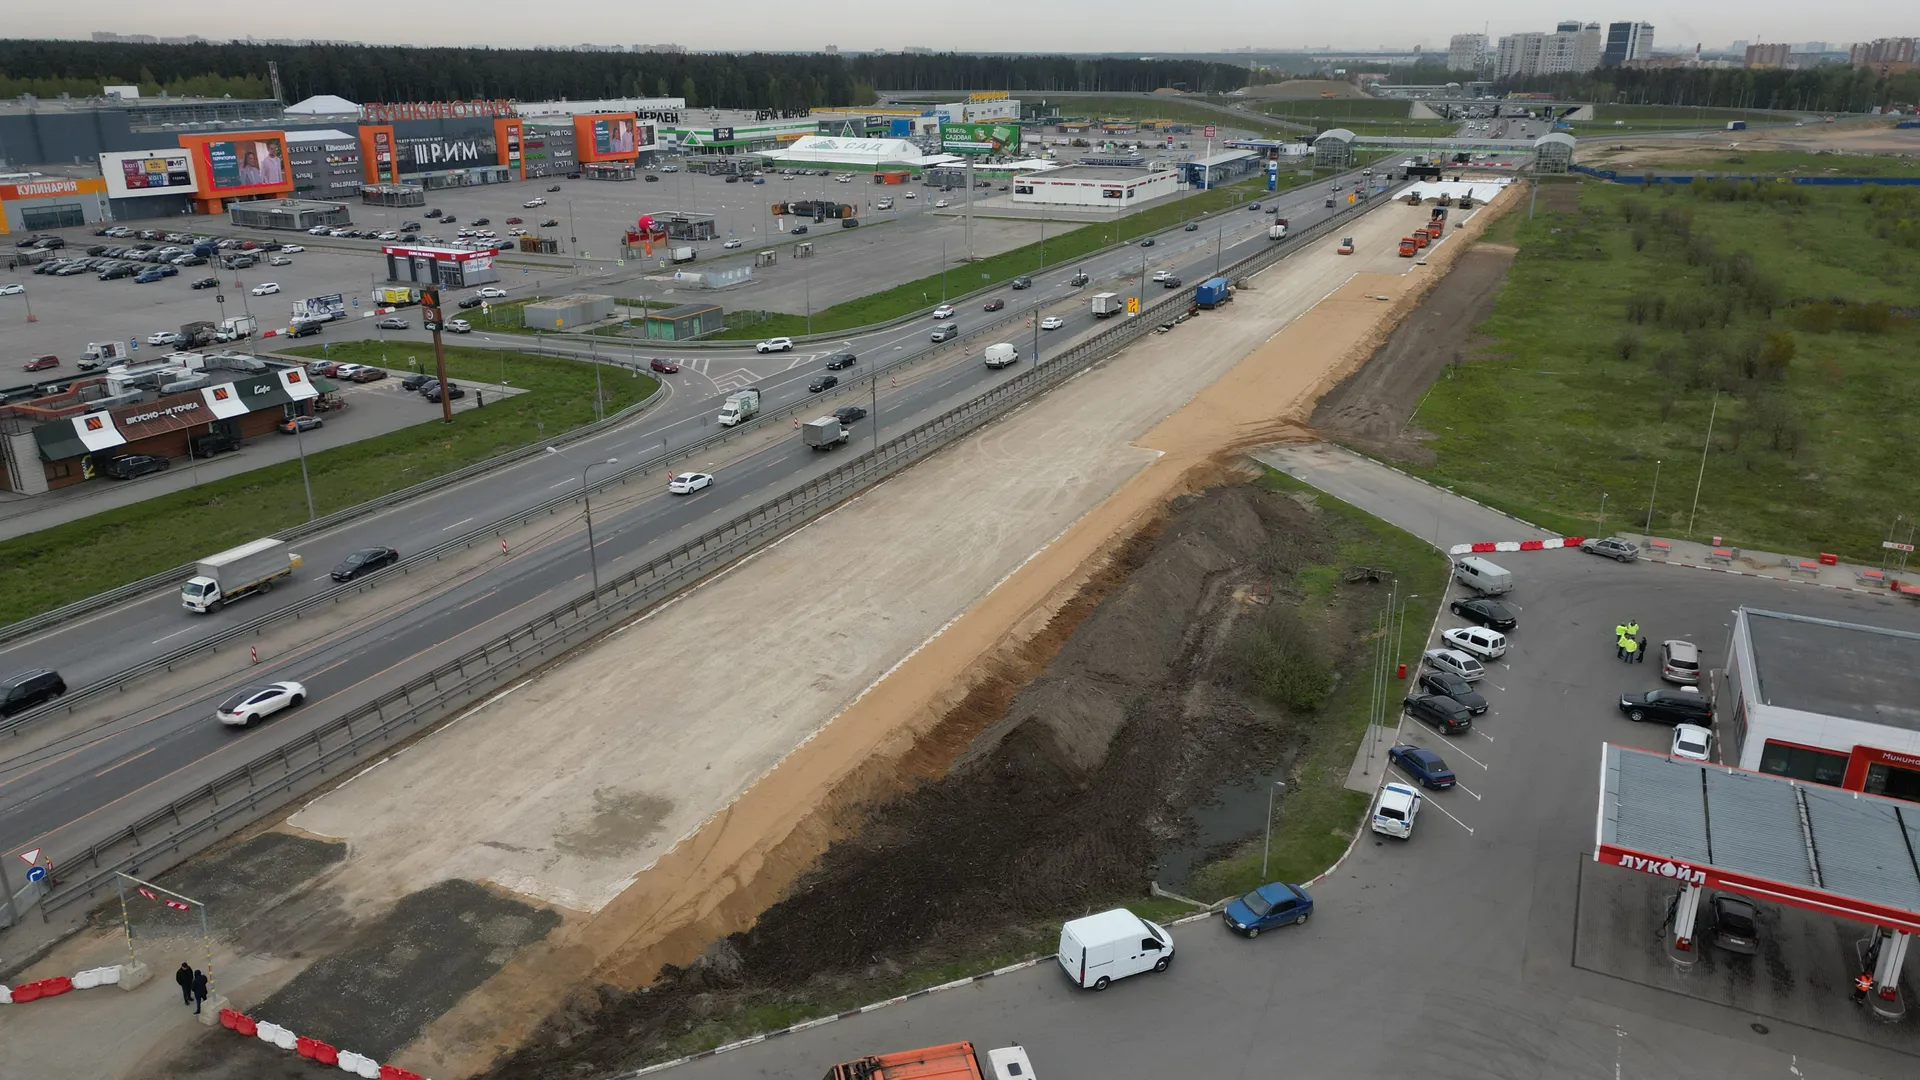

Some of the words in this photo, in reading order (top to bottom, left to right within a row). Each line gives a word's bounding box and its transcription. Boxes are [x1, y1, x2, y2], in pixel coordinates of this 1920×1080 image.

[364, 100, 467, 121] ПУШКИНО
[471, 99, 515, 117] ПАРК
[843, 142, 883, 152] САД
[16, 181, 77, 196] КУЛИНАРИЯ
[173, 402, 200, 413] ТОЧКА
[1618, 854, 1706, 885] ЛУКОЙЛ
